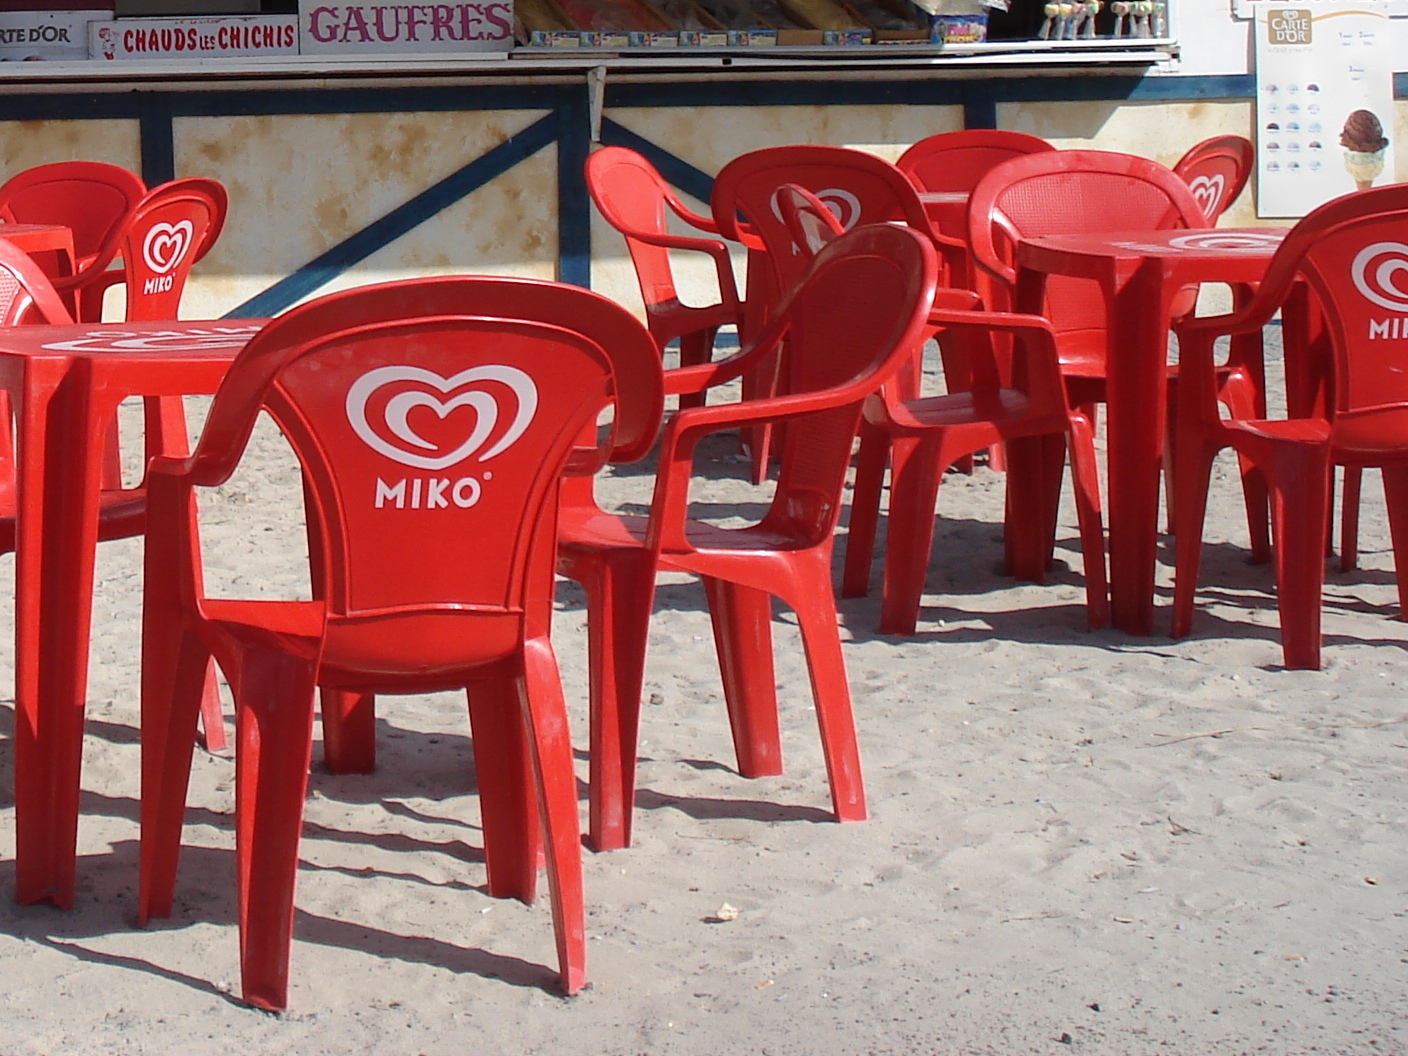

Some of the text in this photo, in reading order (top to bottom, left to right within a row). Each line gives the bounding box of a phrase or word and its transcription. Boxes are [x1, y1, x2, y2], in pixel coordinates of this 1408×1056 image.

[308, 3, 513, 45] GAUFRES
[1271, 18, 1309, 31] CARTE
[123, 25, 294, 53] CHAUDS LES CHICHIS
[1276, 30, 1307, 43] D'OR
[143, 274, 173, 295] MIKO
[374, 476, 482, 509] MIKO
